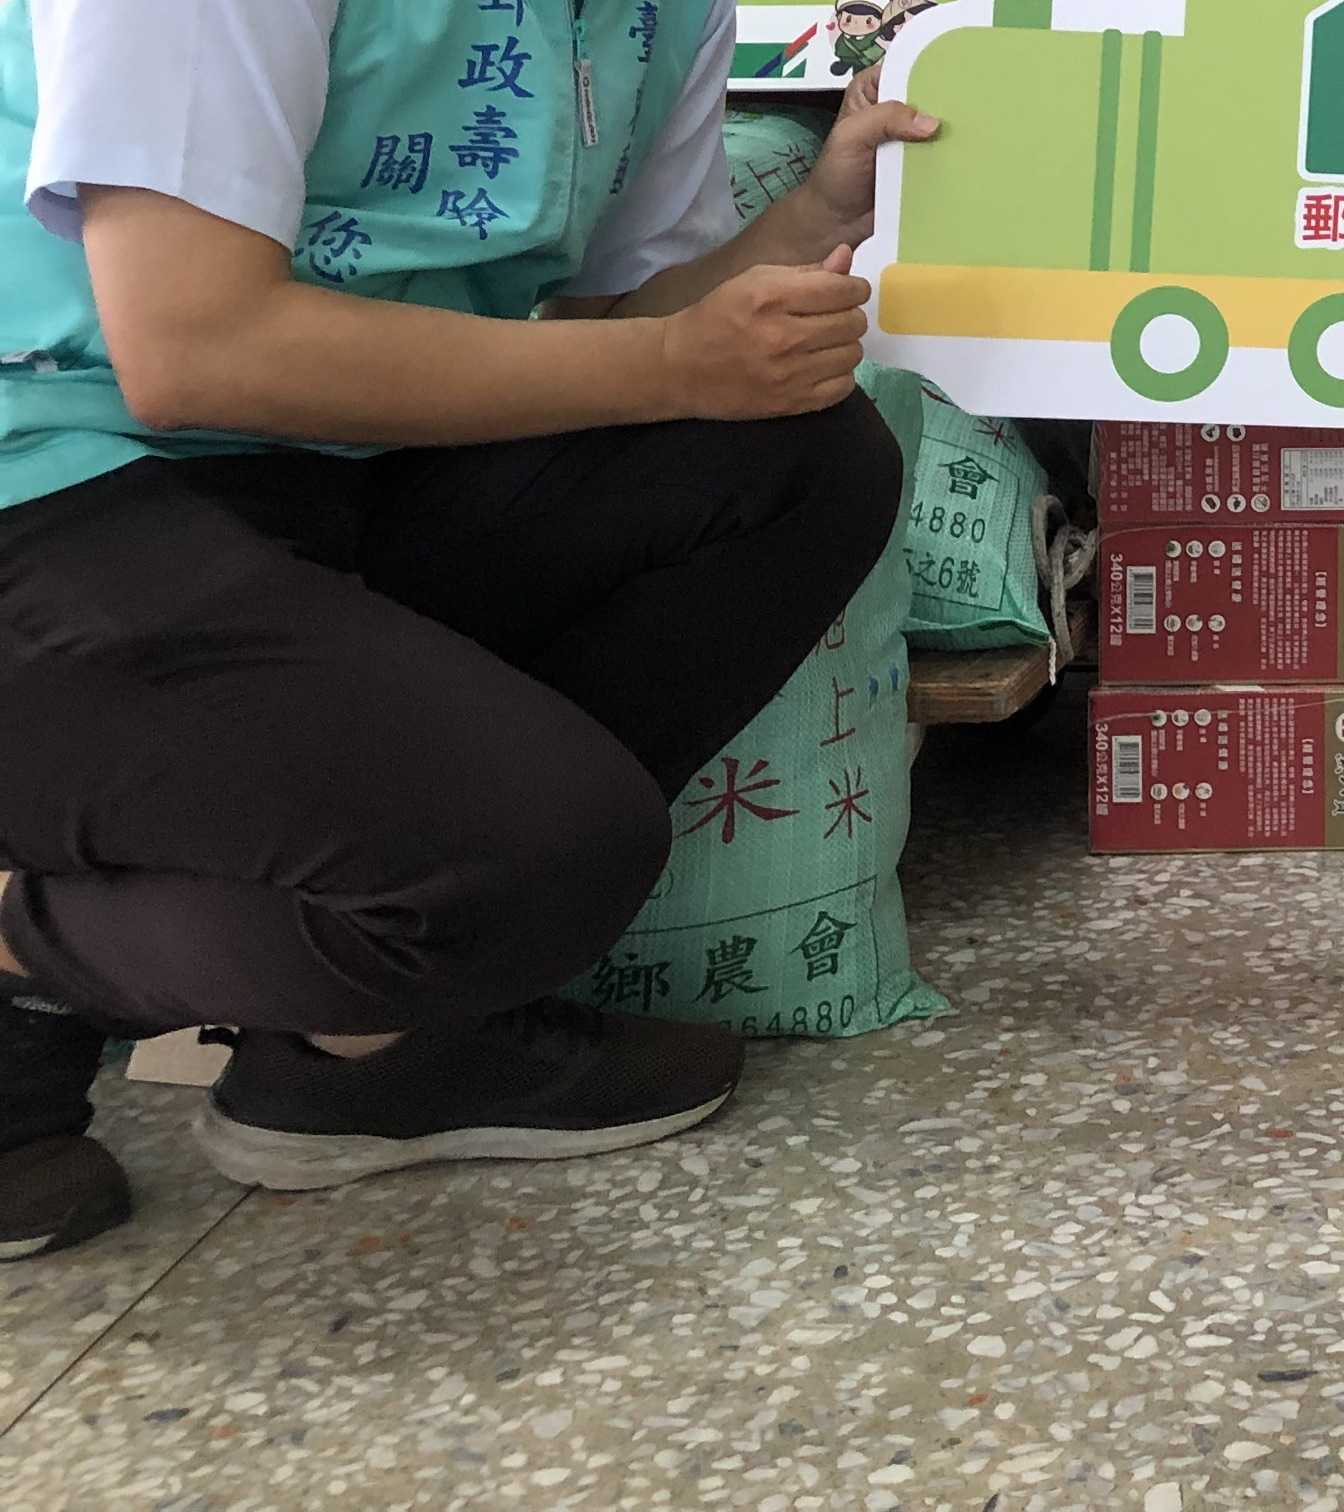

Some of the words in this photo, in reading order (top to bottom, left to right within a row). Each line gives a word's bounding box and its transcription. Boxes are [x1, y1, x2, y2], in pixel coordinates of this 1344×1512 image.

[938, 454, 999, 500] 會
[903, 548, 984, 600] 之6號
[676, 756, 801, 844] 米
